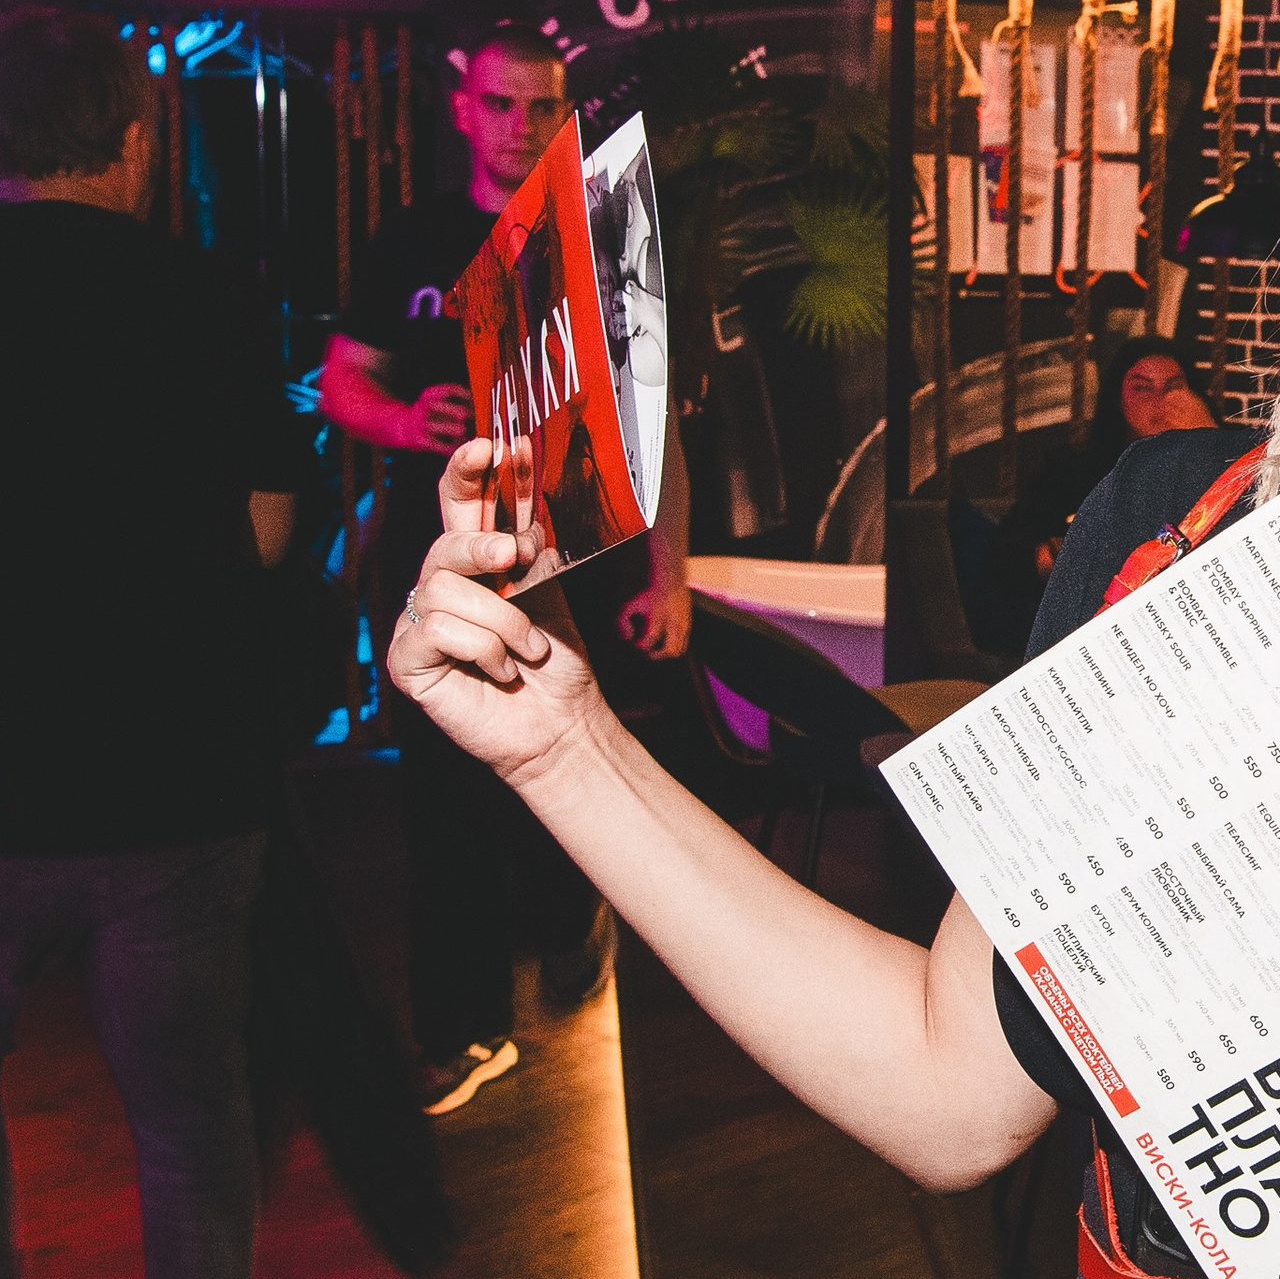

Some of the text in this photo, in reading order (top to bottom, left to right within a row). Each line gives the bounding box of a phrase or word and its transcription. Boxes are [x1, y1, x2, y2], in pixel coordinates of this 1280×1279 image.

[1242, 535, 1273, 578] MARTINI
[1145, 600, 1192, 671] WHISKY SOUR
[908, 761, 945, 813] GIN-TONIC
[1243, 755, 1263, 779] 550
[1003, 907, 1021, 928] 450
[1090, 904, 1116, 937] БУТОН
[1031, 970, 1067, 1019] УКАЗАНЫ
[1067, 1026, 1098, 1067] УЧЕТОМ
[1092, 1066, 1115, 1095] ЛЬДА
[1039, 966, 1125, 1091] ОБЪЕМЫ ВСЕХ КОКТЕЙЛЕЙ
[1187, 1050, 1206, 1072] 590
[1167, 1102, 1270, 1239] ТНО
